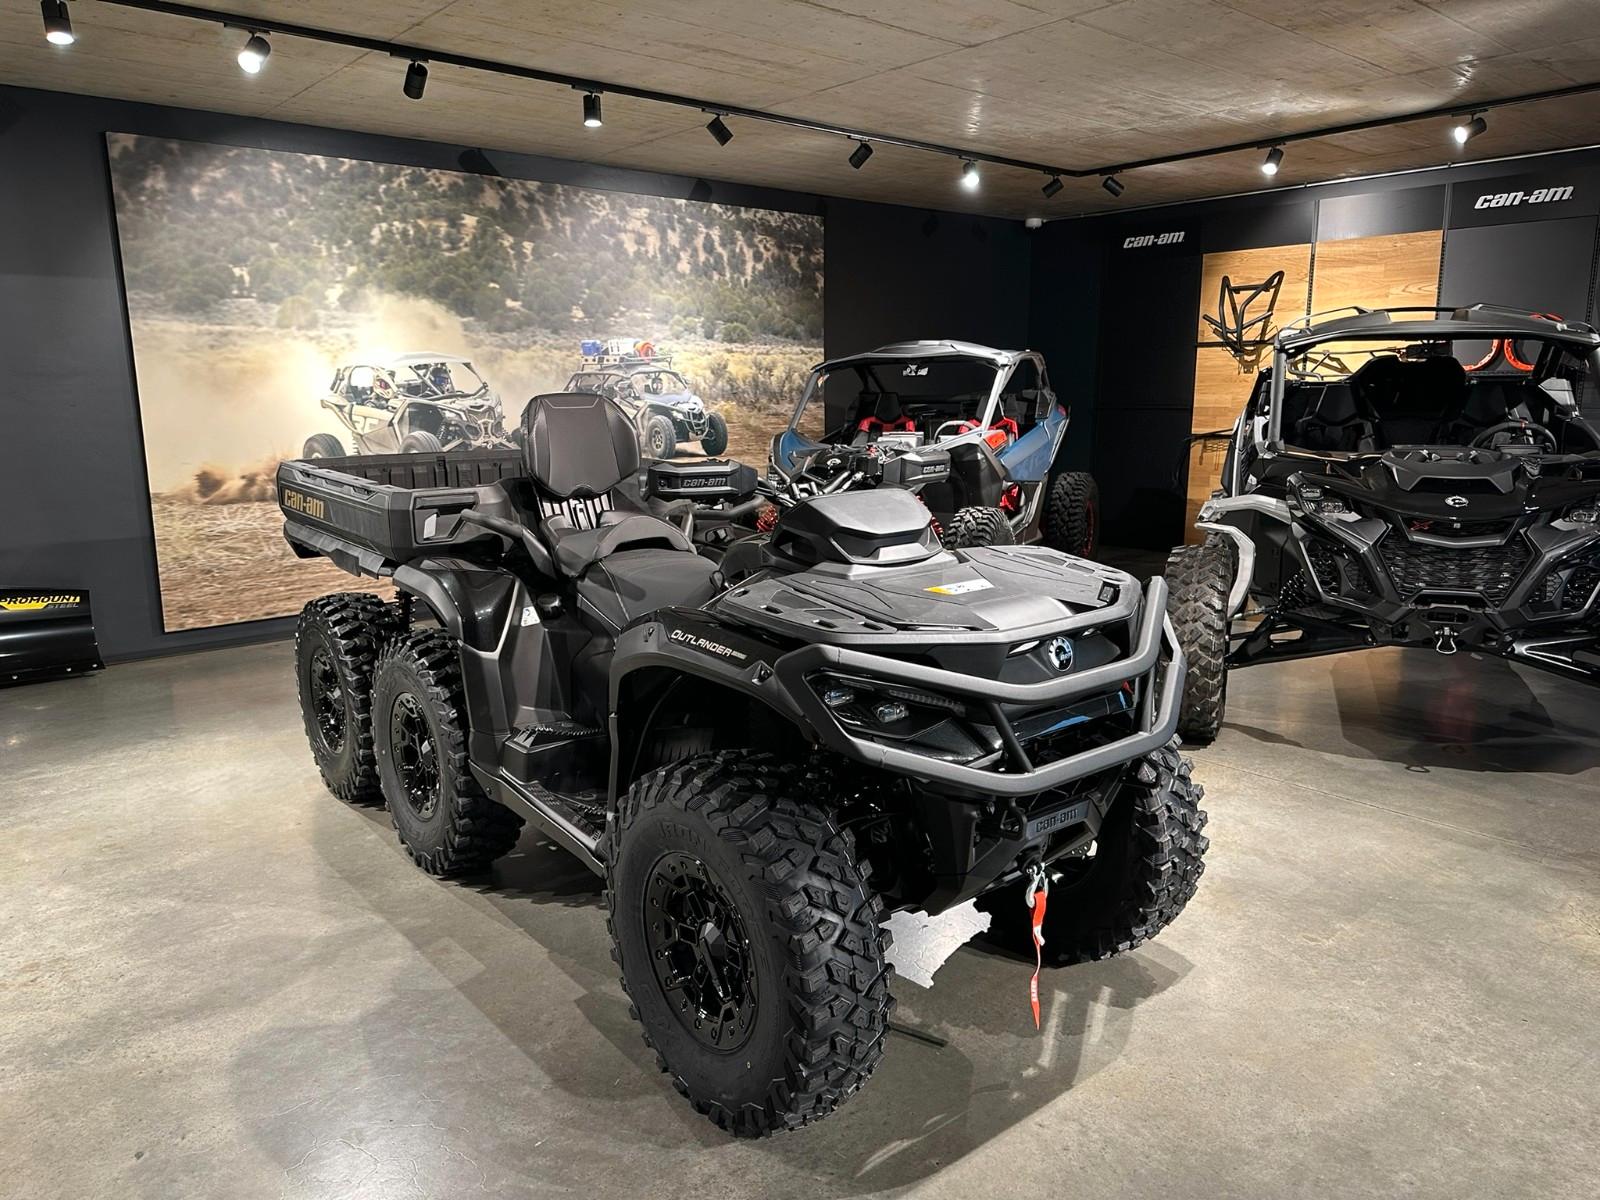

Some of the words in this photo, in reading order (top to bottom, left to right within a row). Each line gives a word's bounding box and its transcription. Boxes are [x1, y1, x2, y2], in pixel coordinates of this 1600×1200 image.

[1474, 186, 1574, 209] can-am
[1123, 231, 1185, 249] can-am
[682, 477, 726, 487] can-am
[284, 489, 325, 519] can-am
[671, 629, 733, 657] OUTLANDER
[1036, 808, 1078, 833] can-am
